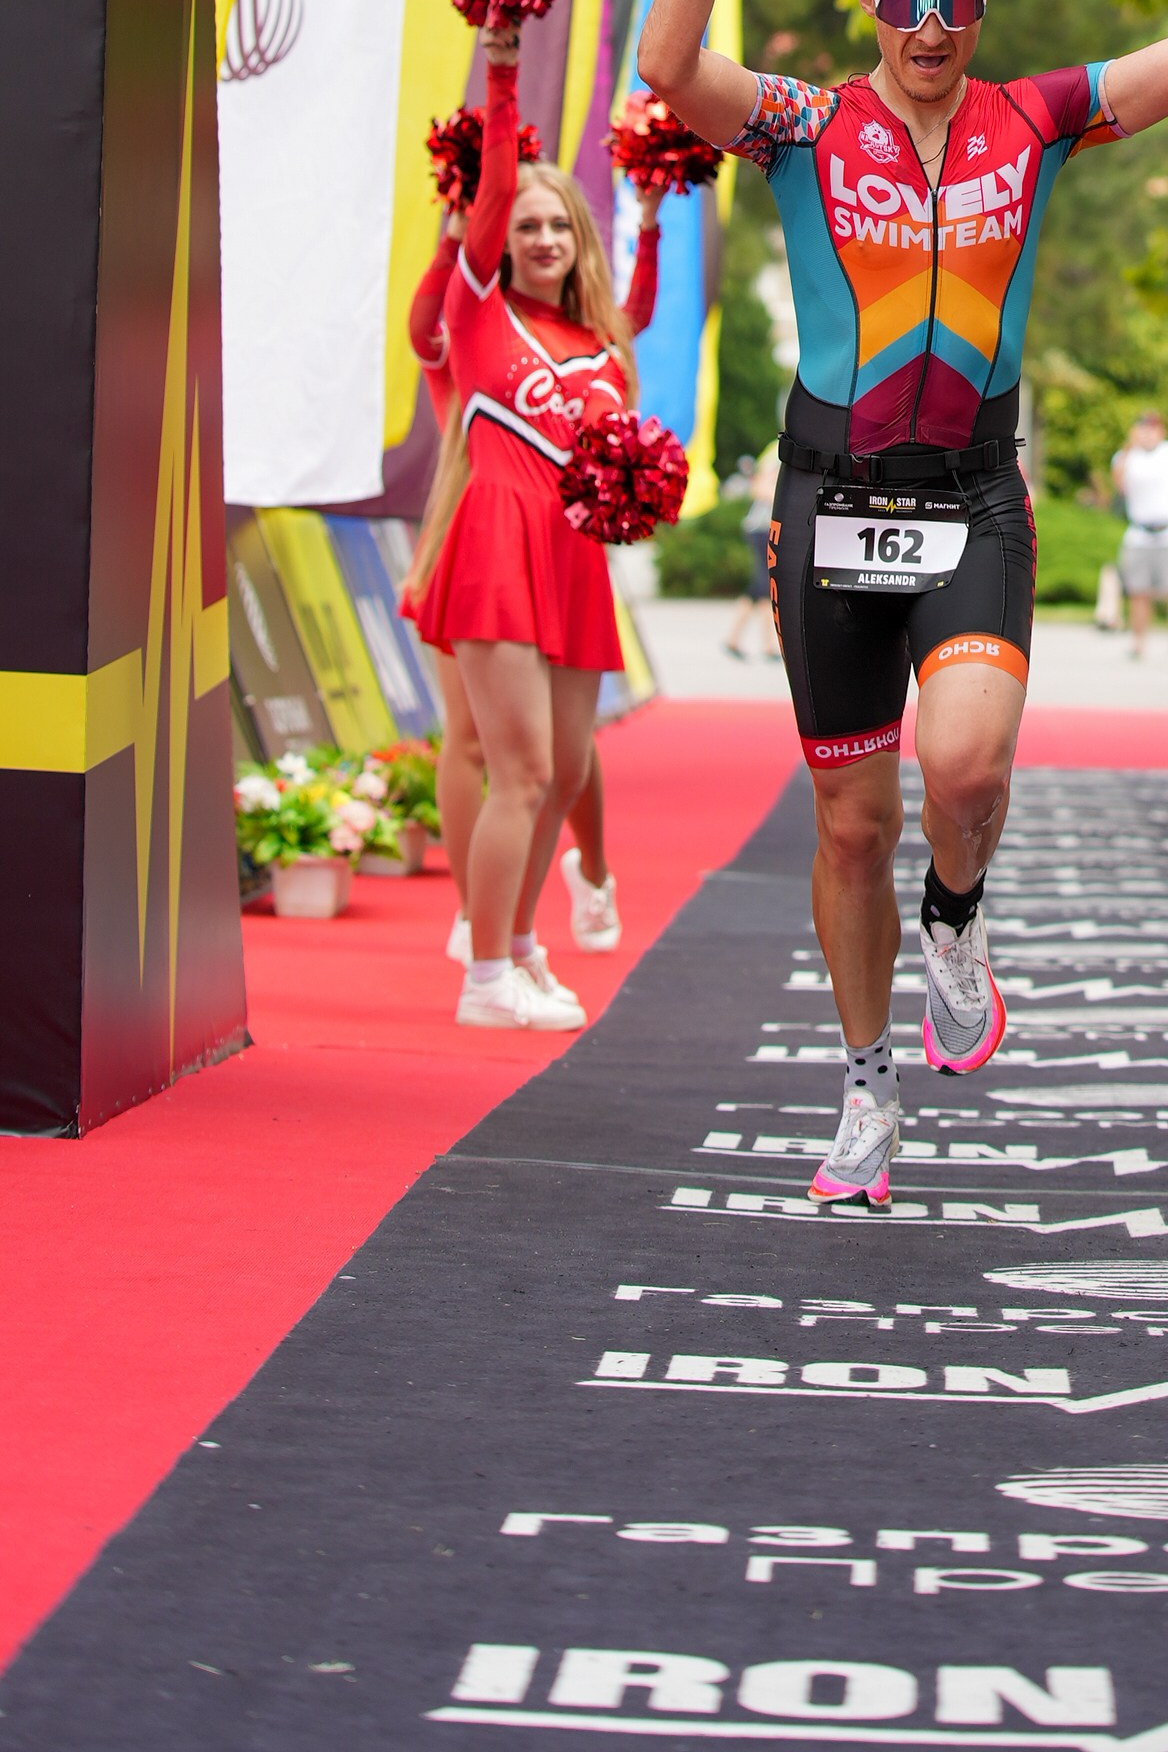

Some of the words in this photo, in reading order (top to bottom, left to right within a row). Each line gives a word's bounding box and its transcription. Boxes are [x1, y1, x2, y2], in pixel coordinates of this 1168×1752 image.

[830, 144, 1031, 223] LOVELY
[514, 368, 585, 422] Coo
[869, 495, 888, 506] IRON
[896, 497, 916, 508] STAR
[933, 503, 960, 511] МАГНИТ
[857, 527, 924, 564] 162
[857, 573, 916, 587] ALEKSANDR
[938, 640, 1000, 661] ЯСНО
[671, 1186, 1041, 1222] IRON
[595, 1350, 1072, 1395] IRON
[450, 1643, 1117, 1727] IRON
